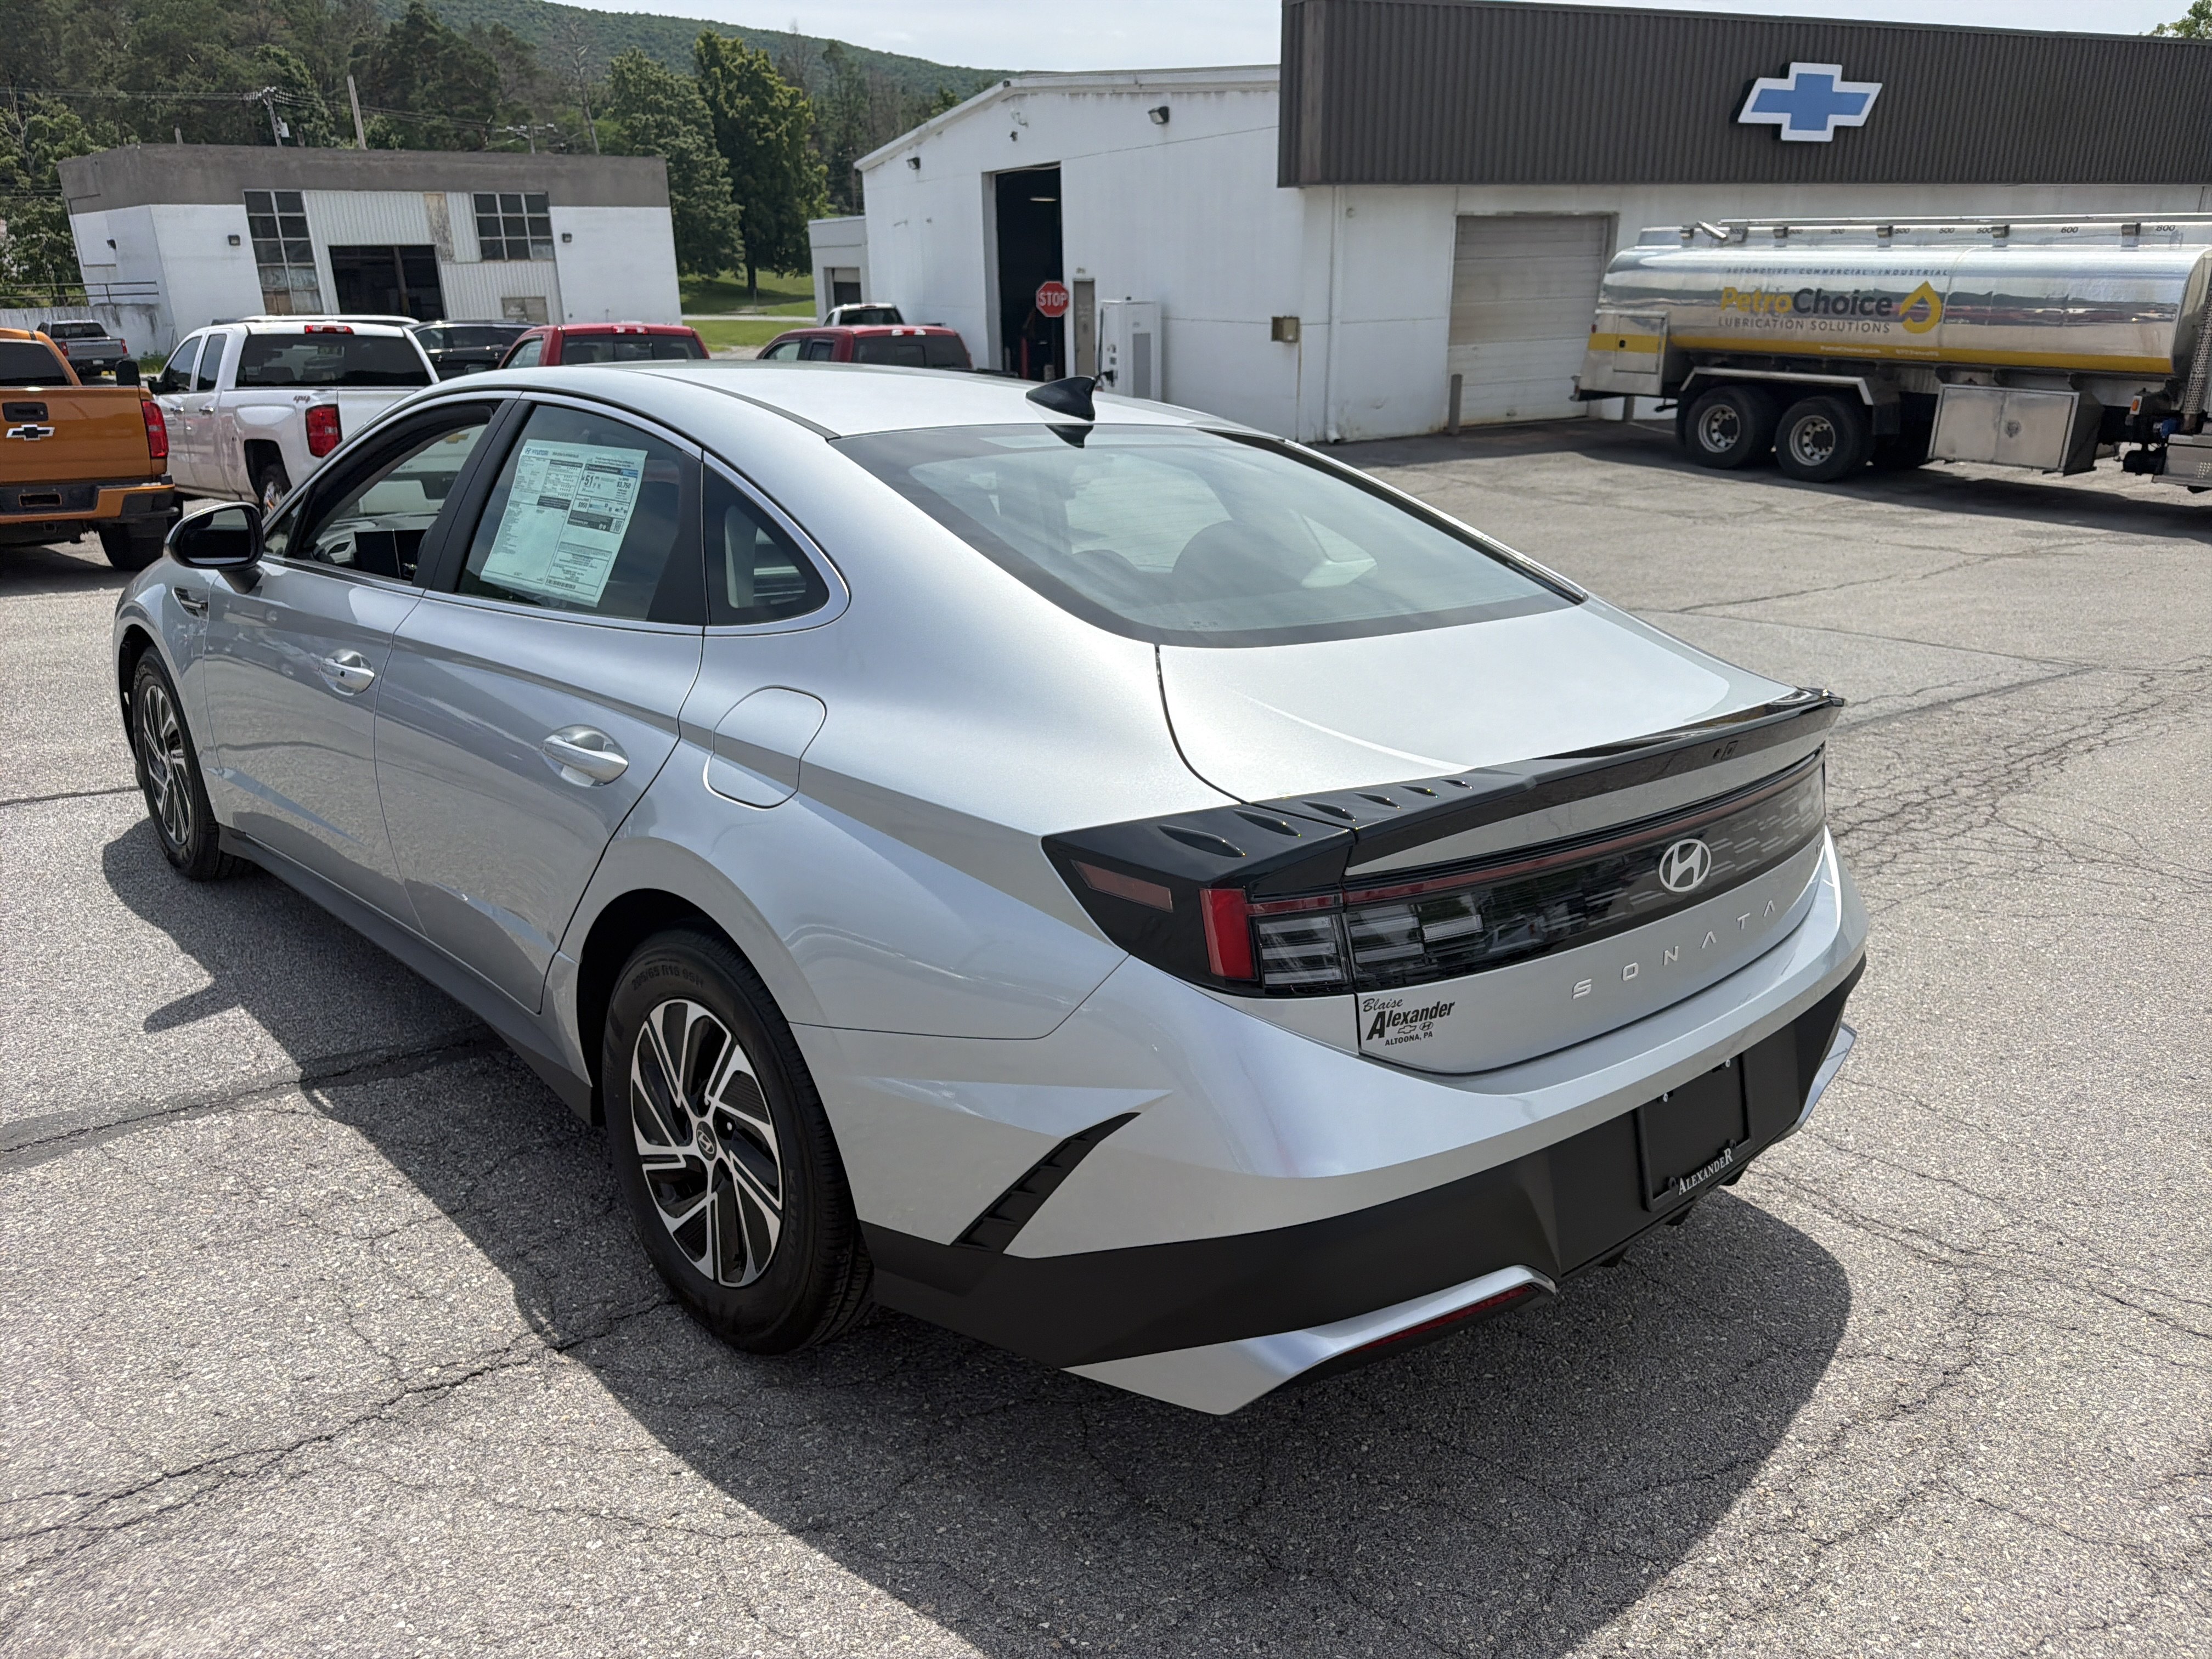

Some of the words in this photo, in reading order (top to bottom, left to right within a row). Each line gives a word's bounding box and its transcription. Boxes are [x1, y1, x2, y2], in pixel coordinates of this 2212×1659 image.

[2061, 225, 2079, 234] 600
[2155, 224, 2176, 233] 800
[1039, 292, 1068, 306] STOP
[1719, 286, 1893, 317] PetroChoice
[1718, 316, 1804, 330] LUBRICATION
[1810, 320, 1891, 334] SOLUTIONS
[1571, 899, 1776, 1000] SONATA
[1362, 997, 1403, 1012] Blaise
[1365, 1001, 1455, 1041] Alexander
[1385, 1034, 1422, 1046] ALTOONA,
[1423, 1031, 1433, 1039] PA
[1679, 1148, 1734, 1196] ALEXANDER
